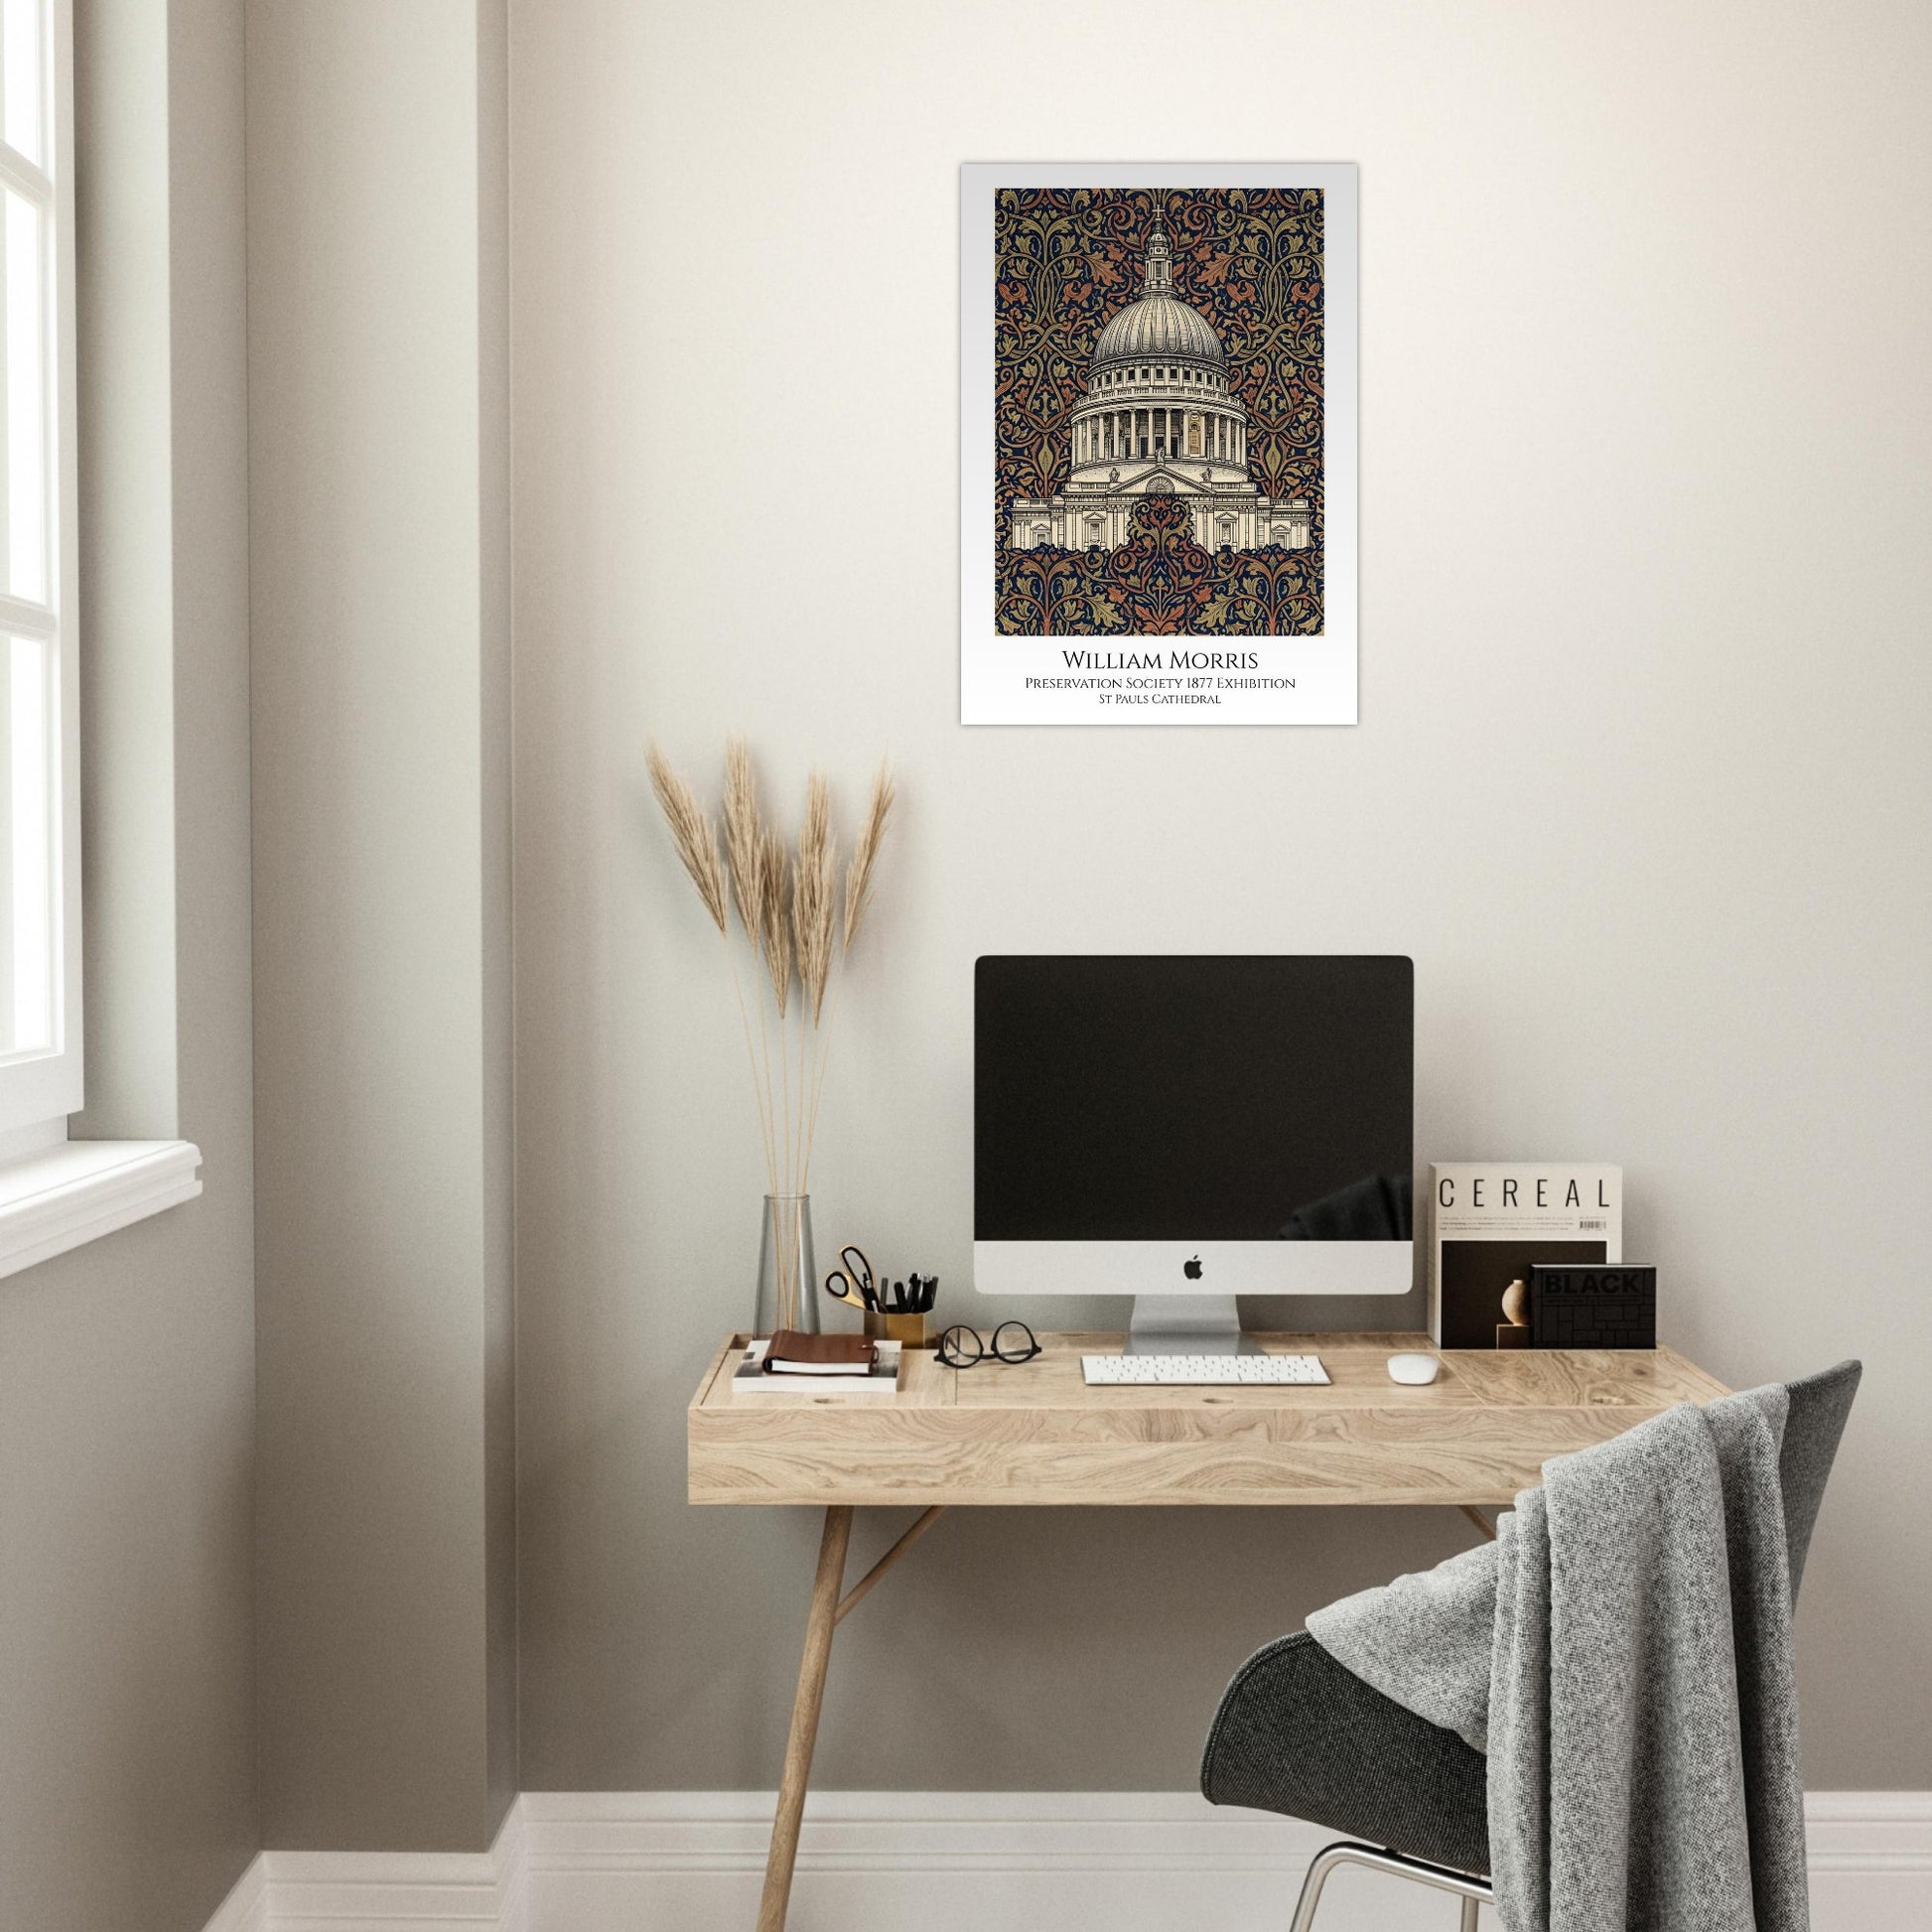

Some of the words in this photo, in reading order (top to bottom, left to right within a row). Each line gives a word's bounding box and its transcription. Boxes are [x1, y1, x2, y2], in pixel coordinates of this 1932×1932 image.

[1061, 650, 1163, 670] WILLIAM
[1169, 650, 1259, 670] MORRIS
[1026, 677, 1123, 689] PRESERVATION
[1125, 677, 1183, 689] SOCIETY
[1186, 677, 1213, 689] 1877
[1217, 677, 1296, 689] EXHIBITION
[1151, 693, 1222, 705] CATHEDRAL
[1439, 1177, 1610, 1208] CEREAL
[1545, 1274, 1641, 1295] BLACK
